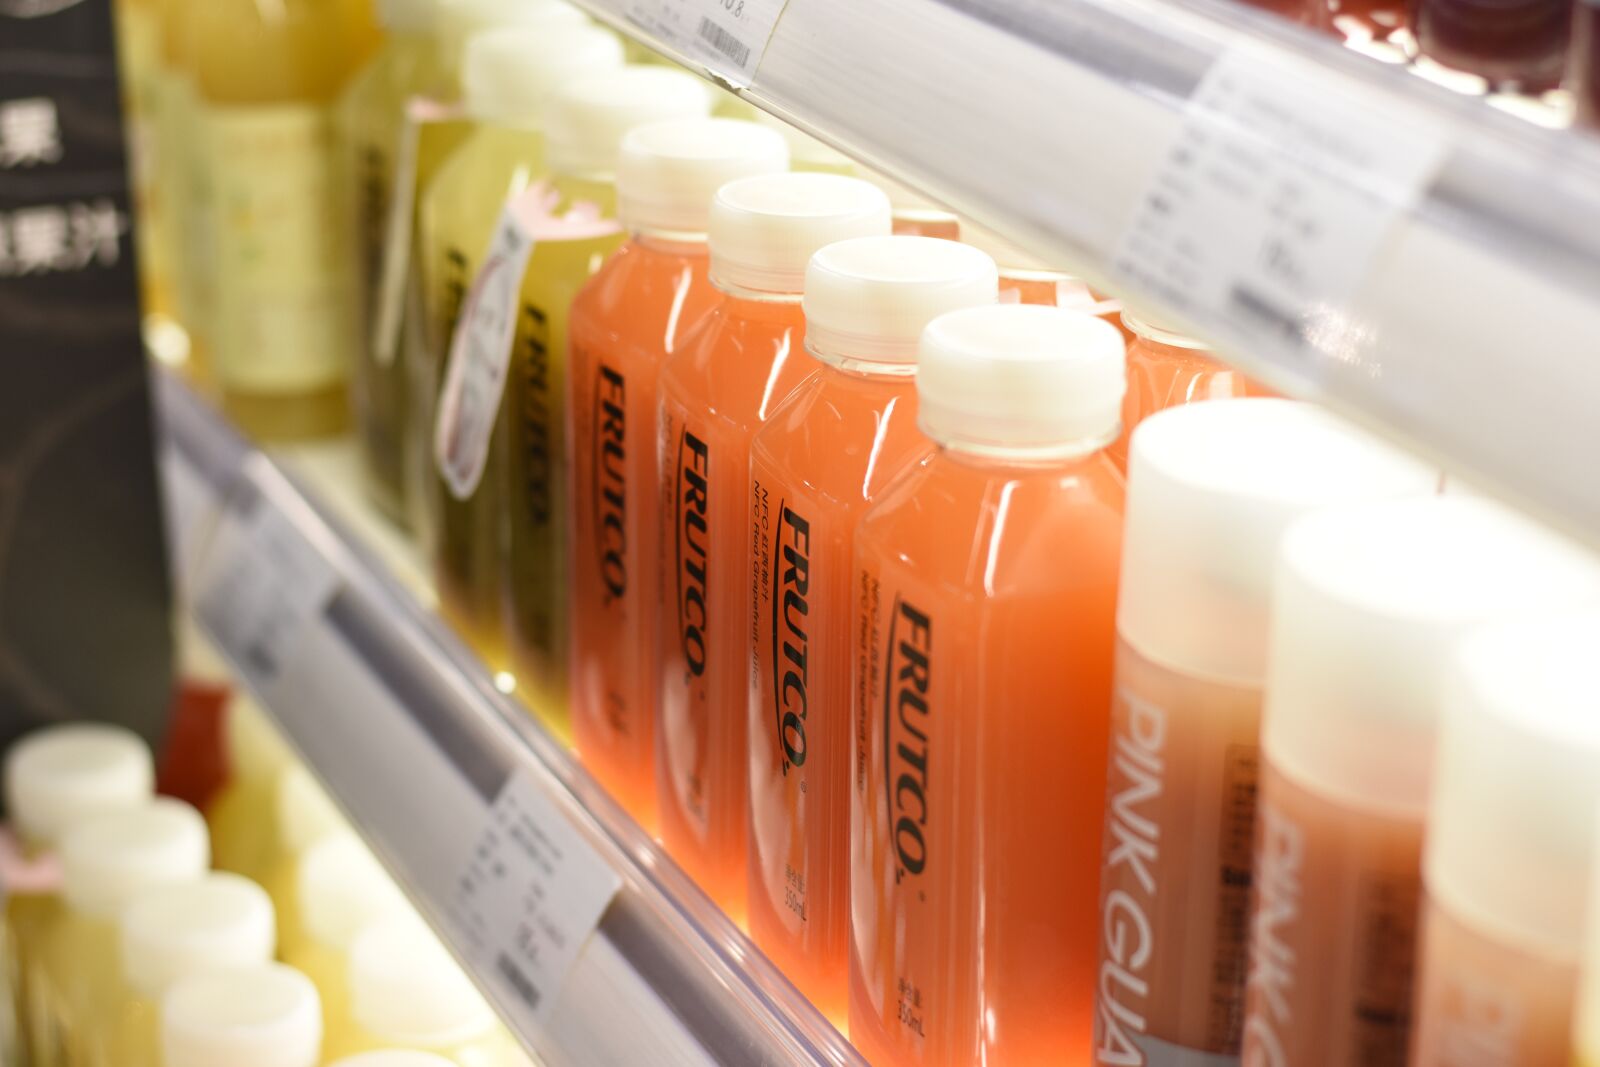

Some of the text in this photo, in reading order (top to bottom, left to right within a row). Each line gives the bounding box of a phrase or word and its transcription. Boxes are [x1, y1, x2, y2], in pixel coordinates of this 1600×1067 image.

[0, 199, 127, 276] 果汁
[600, 365, 626, 600] FRUTCO
[684, 431, 709, 677] FRUTCO
[753, 480, 761, 518] NFC
[761, 487, 769, 530] NFC
[751, 561, 760, 643] Grapefruit
[783, 507, 810, 768] FRUTCO
[896, 601, 932, 876] FRUTCO
[1108, 692, 1165, 894] PINK
